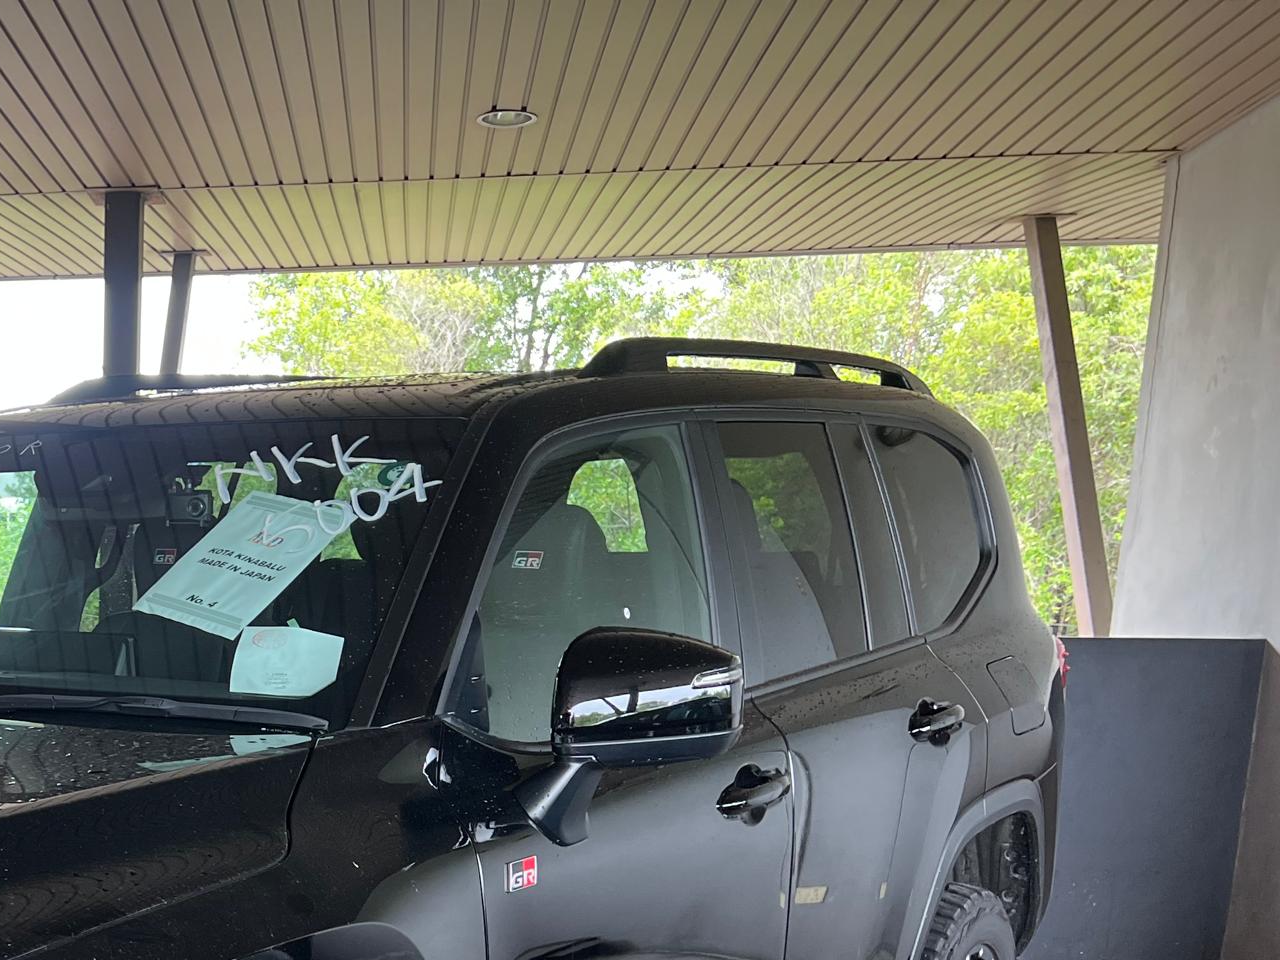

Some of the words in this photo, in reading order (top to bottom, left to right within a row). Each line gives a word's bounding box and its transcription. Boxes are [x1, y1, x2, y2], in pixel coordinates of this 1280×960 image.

[198, 557, 228, 568] MADE
[226, 564, 241, 573] IN
[240, 568, 276, 582] JAPAN
[208, 547, 235, 558] KOTA
[234, 553, 287, 572] KINABALU
